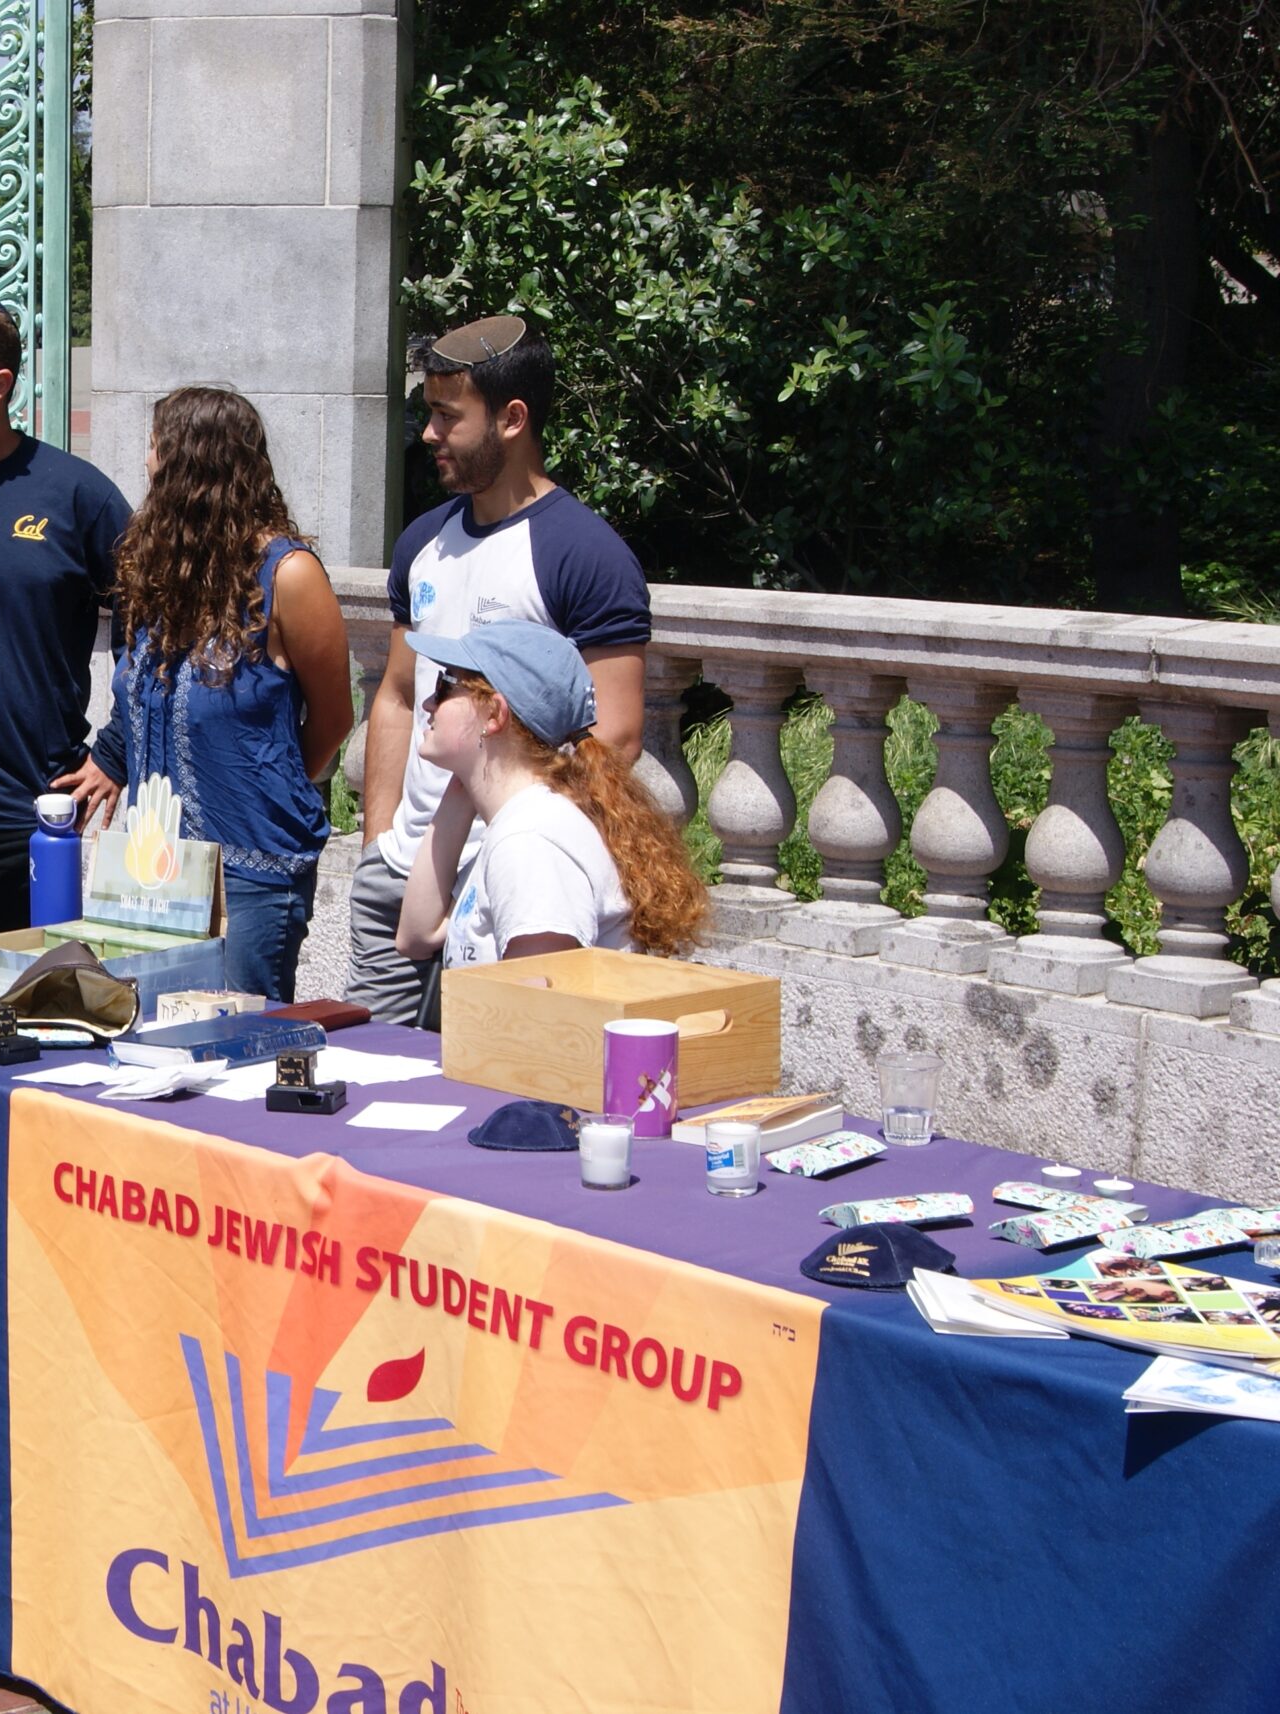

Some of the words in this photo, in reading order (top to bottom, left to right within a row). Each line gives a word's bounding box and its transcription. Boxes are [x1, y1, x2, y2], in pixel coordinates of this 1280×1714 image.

[13, 515, 48, 540] Cal
[53, 1162, 200, 1237] CHABAD
[208, 1205, 341, 1286] JEWISH
[356, 1246, 554, 1350] STUDENT
[563, 1315, 743, 1411] GROUP
[106, 1548, 447, 1714] Chabad
